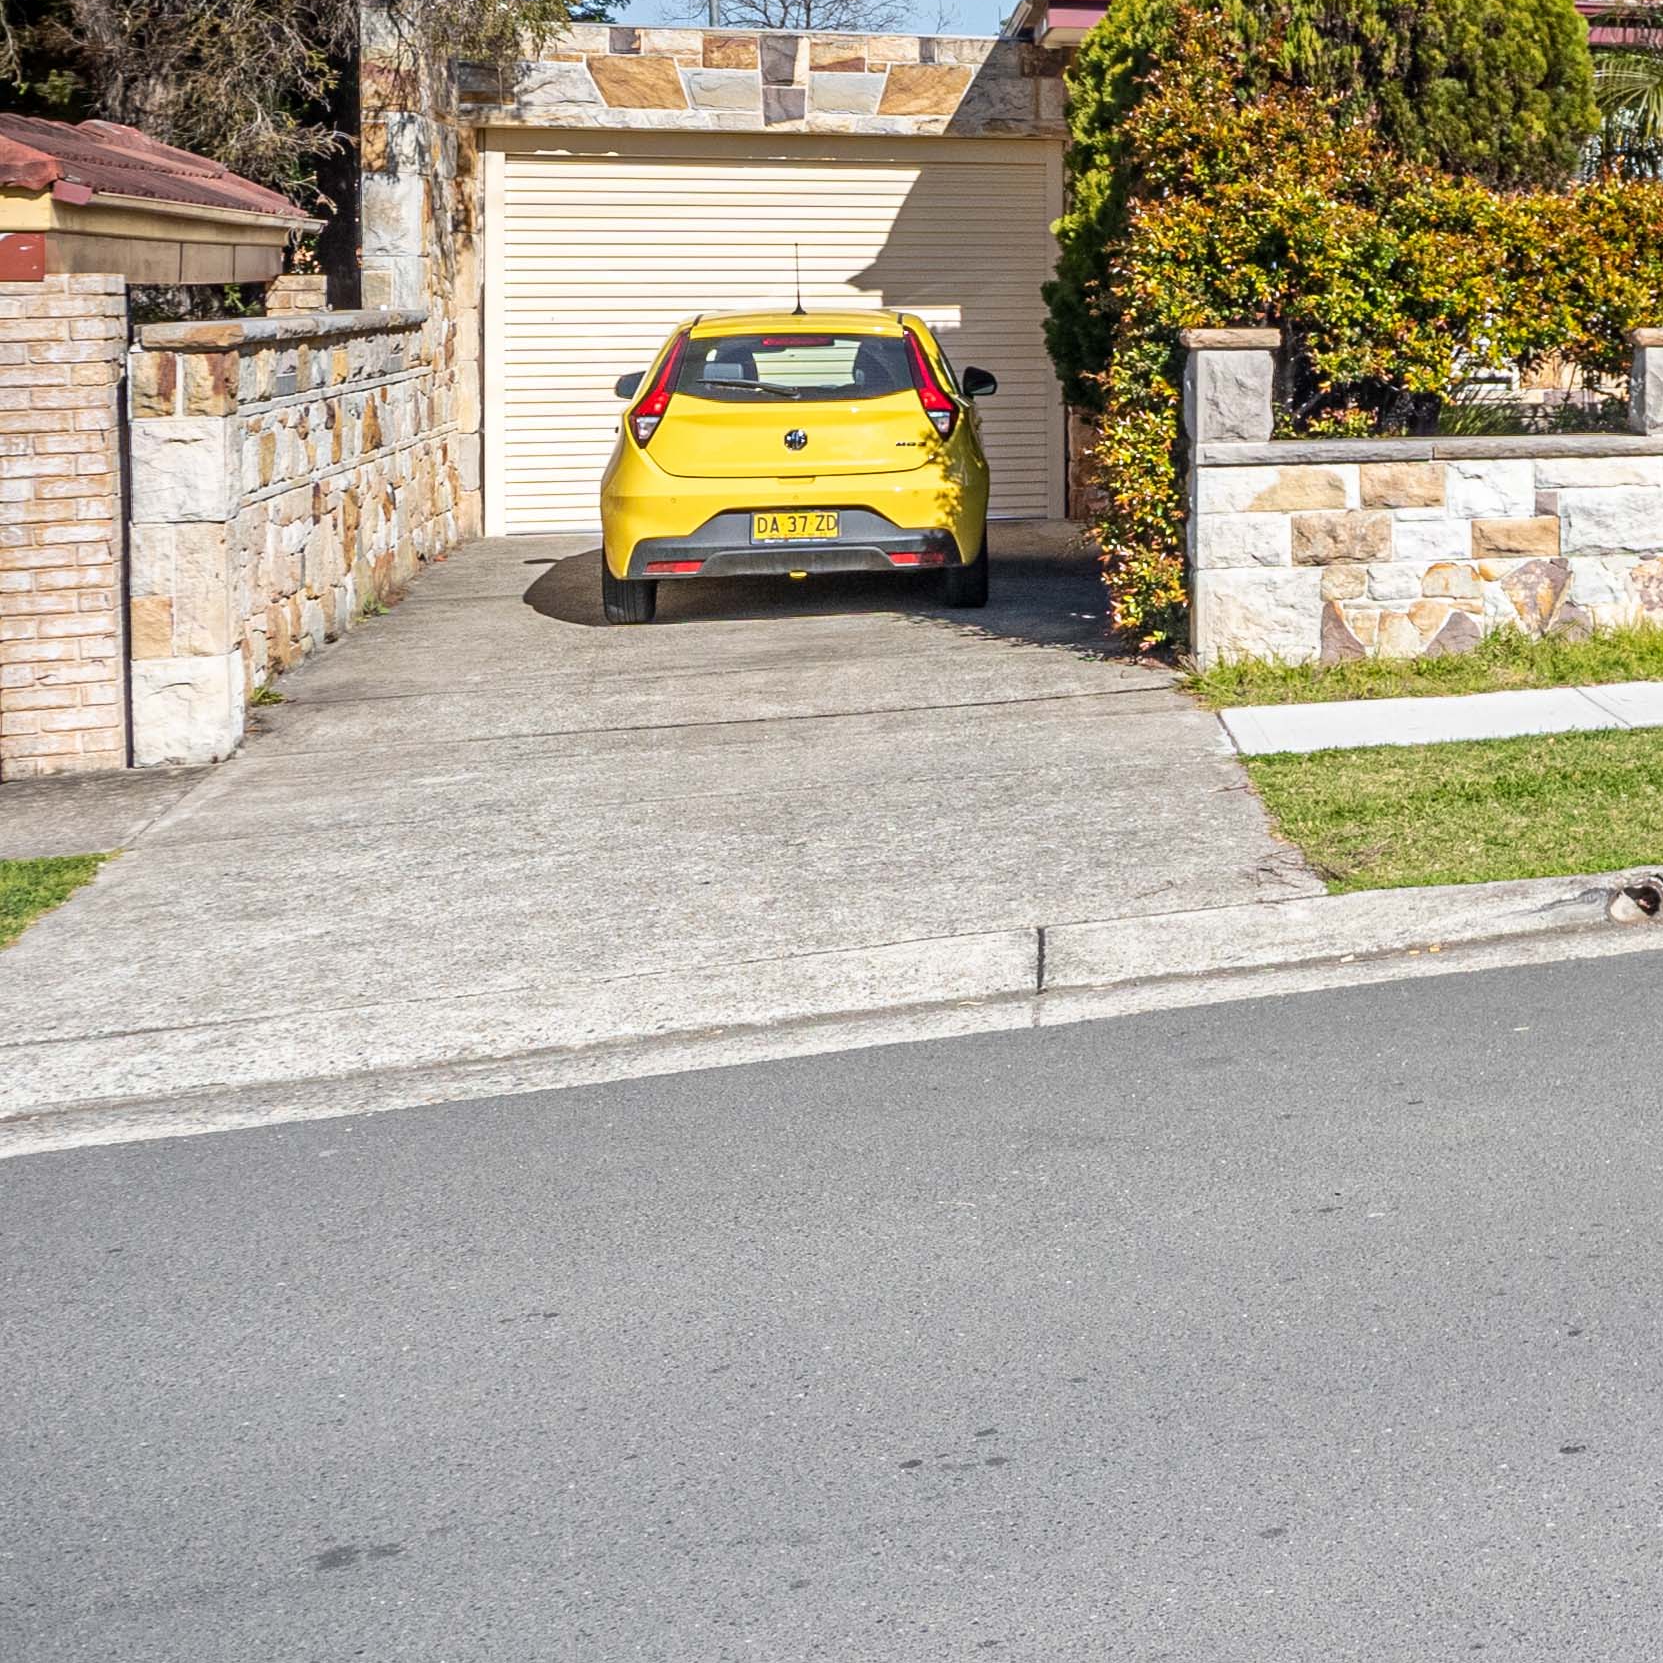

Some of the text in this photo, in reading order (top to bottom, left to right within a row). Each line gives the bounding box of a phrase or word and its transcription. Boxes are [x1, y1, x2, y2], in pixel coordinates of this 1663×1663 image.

[757, 514, 838, 534] DA 37 ZD
